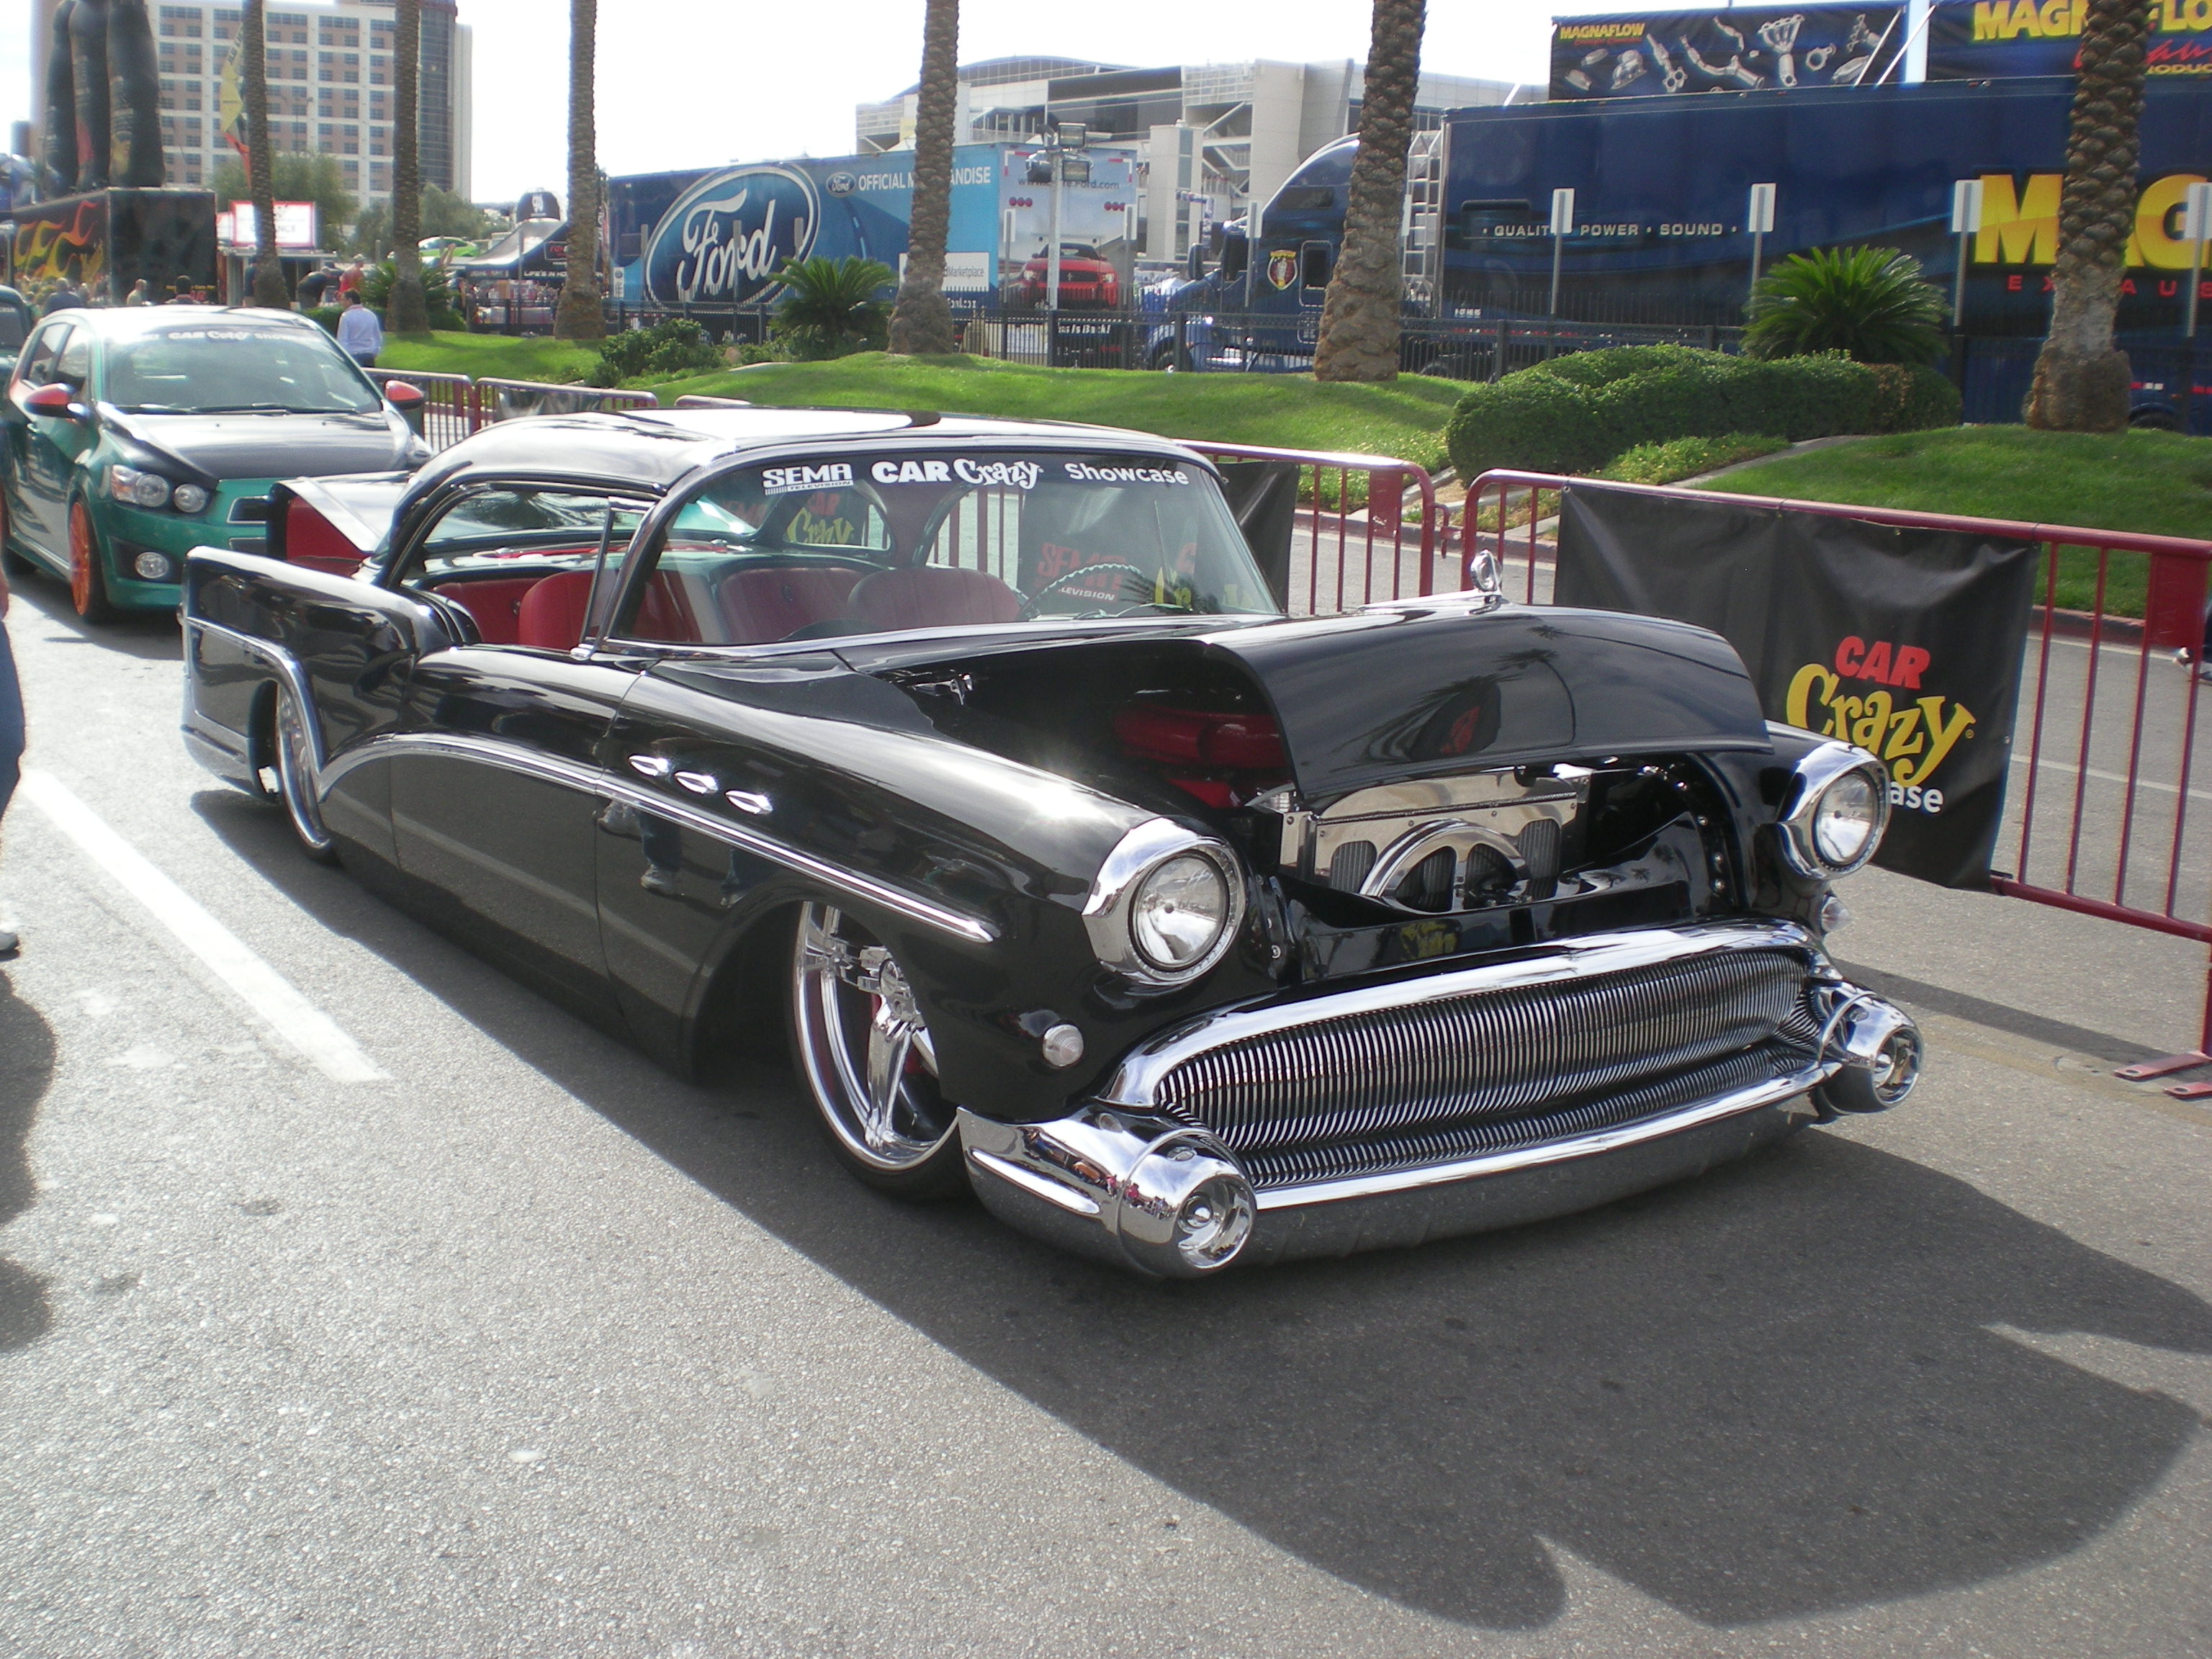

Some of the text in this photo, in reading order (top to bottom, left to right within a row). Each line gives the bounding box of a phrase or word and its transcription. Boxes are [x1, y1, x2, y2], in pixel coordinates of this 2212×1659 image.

[1560, 23, 1645, 39] MAGNAFLOW
[858, 172, 906, 191] OFFICIAL
[1494, 223, 1724, 237] QUALIT POWER SOUND
[676, 188, 776, 302] Ford
[762, 457, 1190, 490] SEMA CAR Crazy Showcase
[789, 480, 853, 491] TELEVISION
[1058, 586, 1115, 601] LEVISION
[1835, 636, 1931, 690] CAR
[1786, 663, 1977, 787] Crazy
